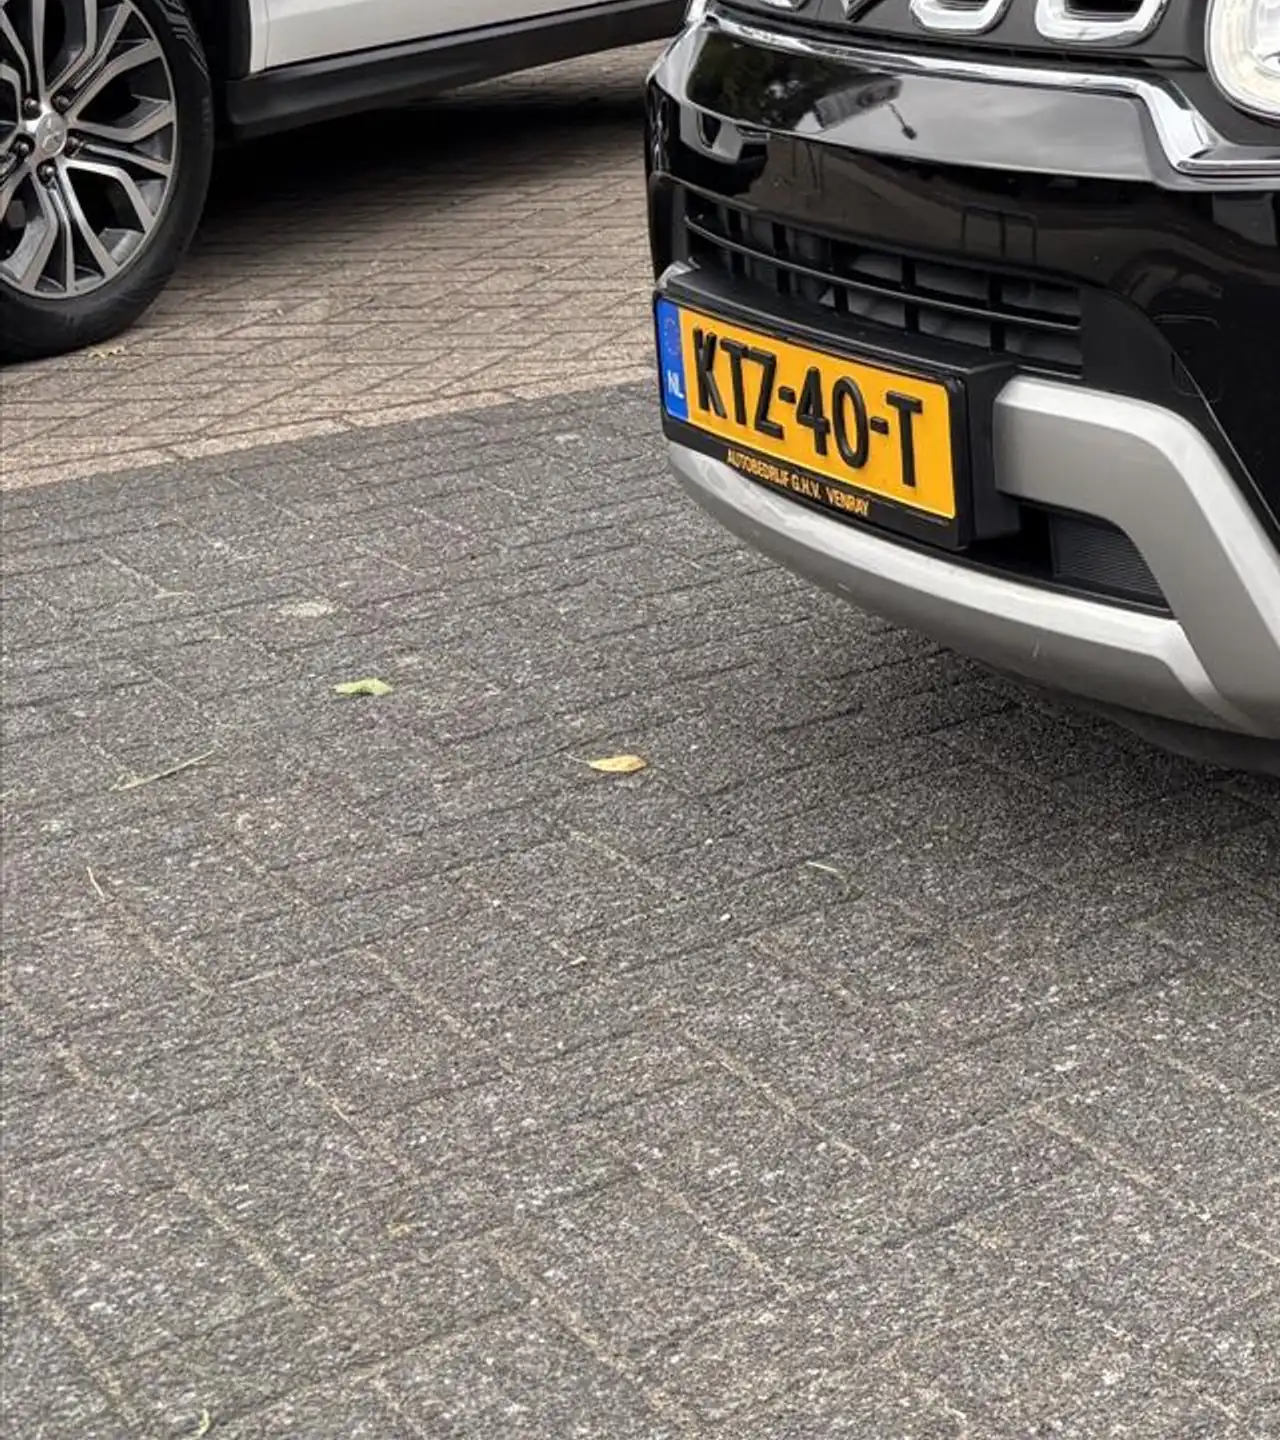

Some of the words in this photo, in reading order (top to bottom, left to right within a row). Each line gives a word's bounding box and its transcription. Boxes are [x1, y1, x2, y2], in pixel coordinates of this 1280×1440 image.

[667, 368, 685, 400] NL
[692, 327, 924, 488] KTZ-40-T
[825, 486, 869, 517] VENRAY
